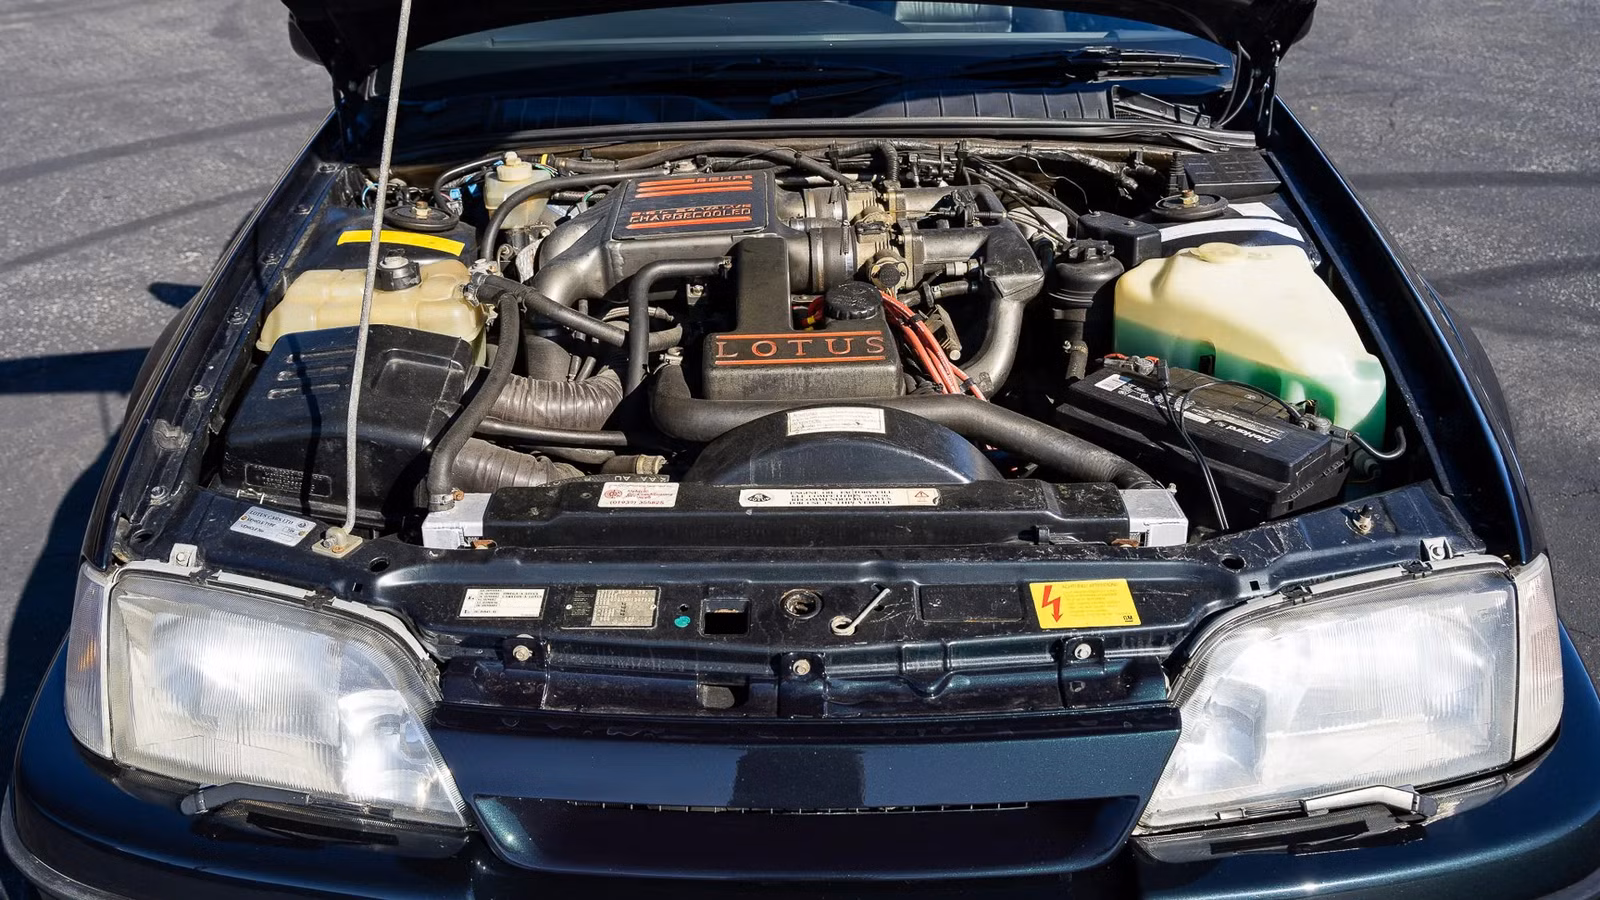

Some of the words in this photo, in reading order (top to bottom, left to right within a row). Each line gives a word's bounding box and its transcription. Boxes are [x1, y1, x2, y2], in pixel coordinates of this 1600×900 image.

[629, 207, 752, 223] CHARGECOOLED
[715, 336, 886, 358] LOTUS
[1225, 425, 1274, 444] DieHard
[249, 510, 267, 518] LOTUS
[267, 514, 282, 522] CARS
